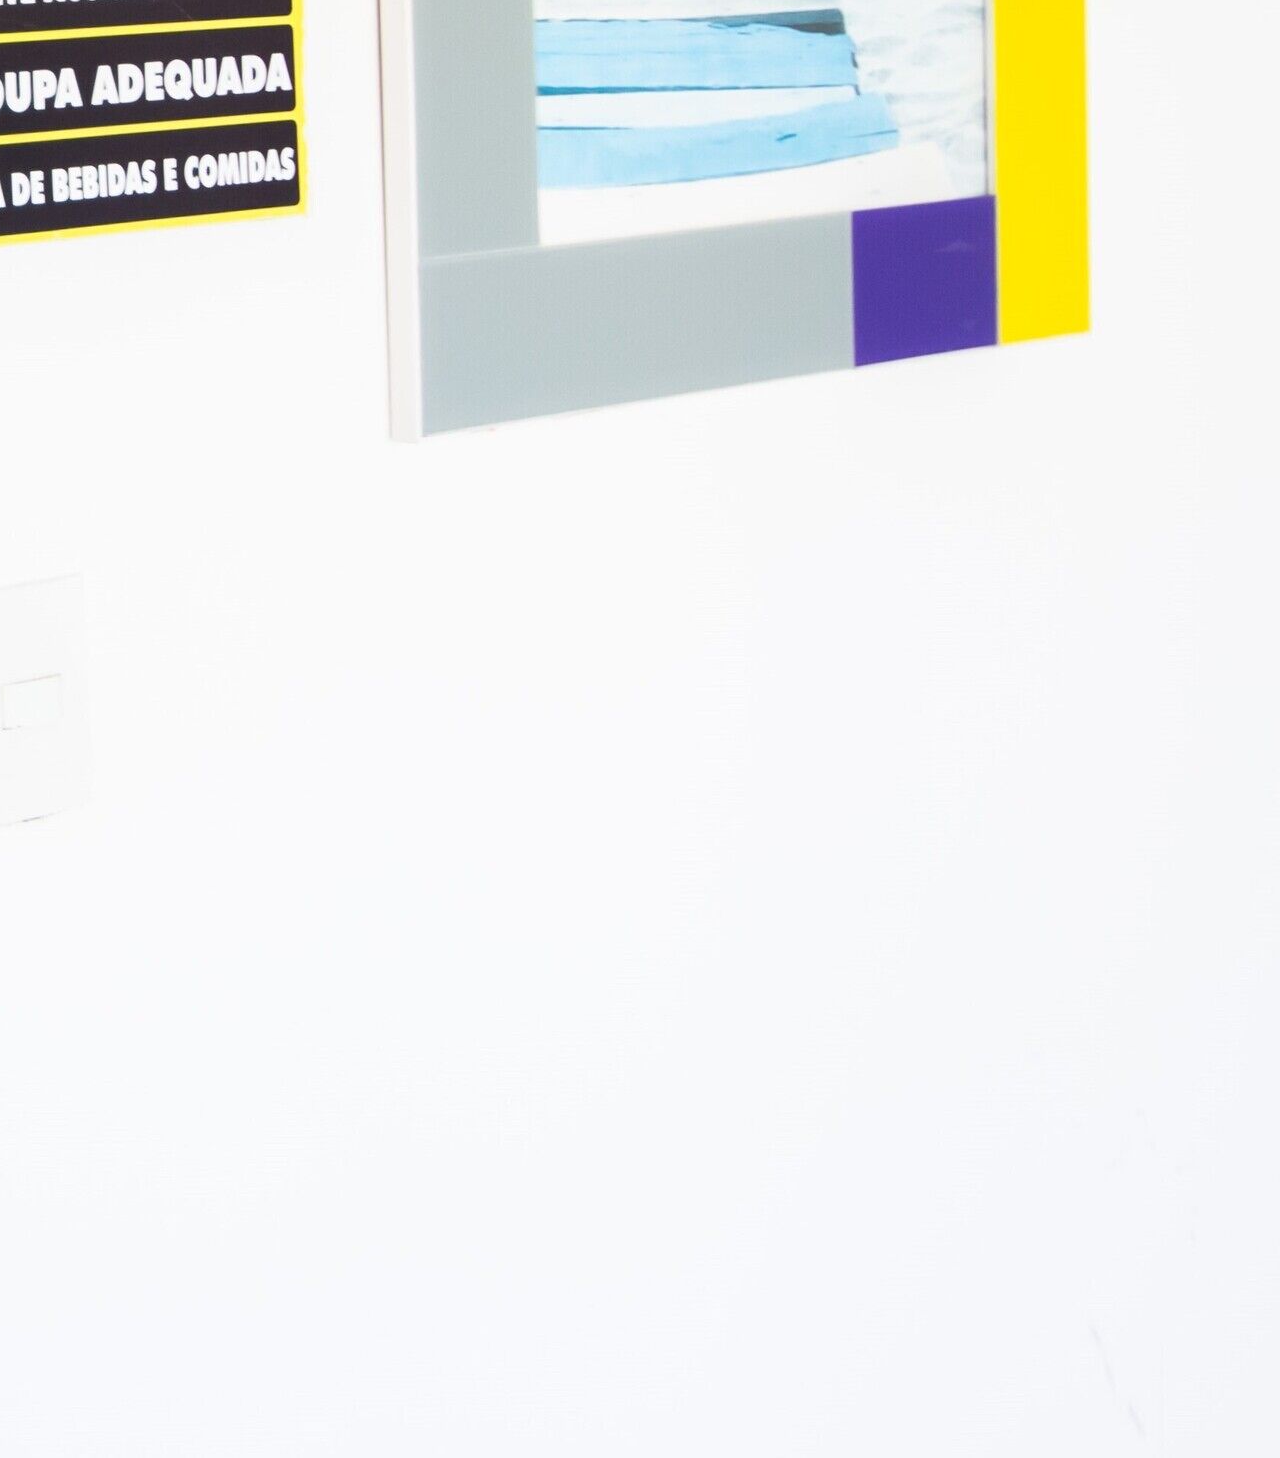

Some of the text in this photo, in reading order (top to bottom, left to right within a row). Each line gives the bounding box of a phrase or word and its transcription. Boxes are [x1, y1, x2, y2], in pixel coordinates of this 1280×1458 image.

[91, 53, 292, 106] ADEQUADA
[12, 172, 44, 206] DE
[52, 161, 157, 201] BEBIDAS
[164, 158, 178, 190] E
[184, 147, 296, 187] COMIDAS
